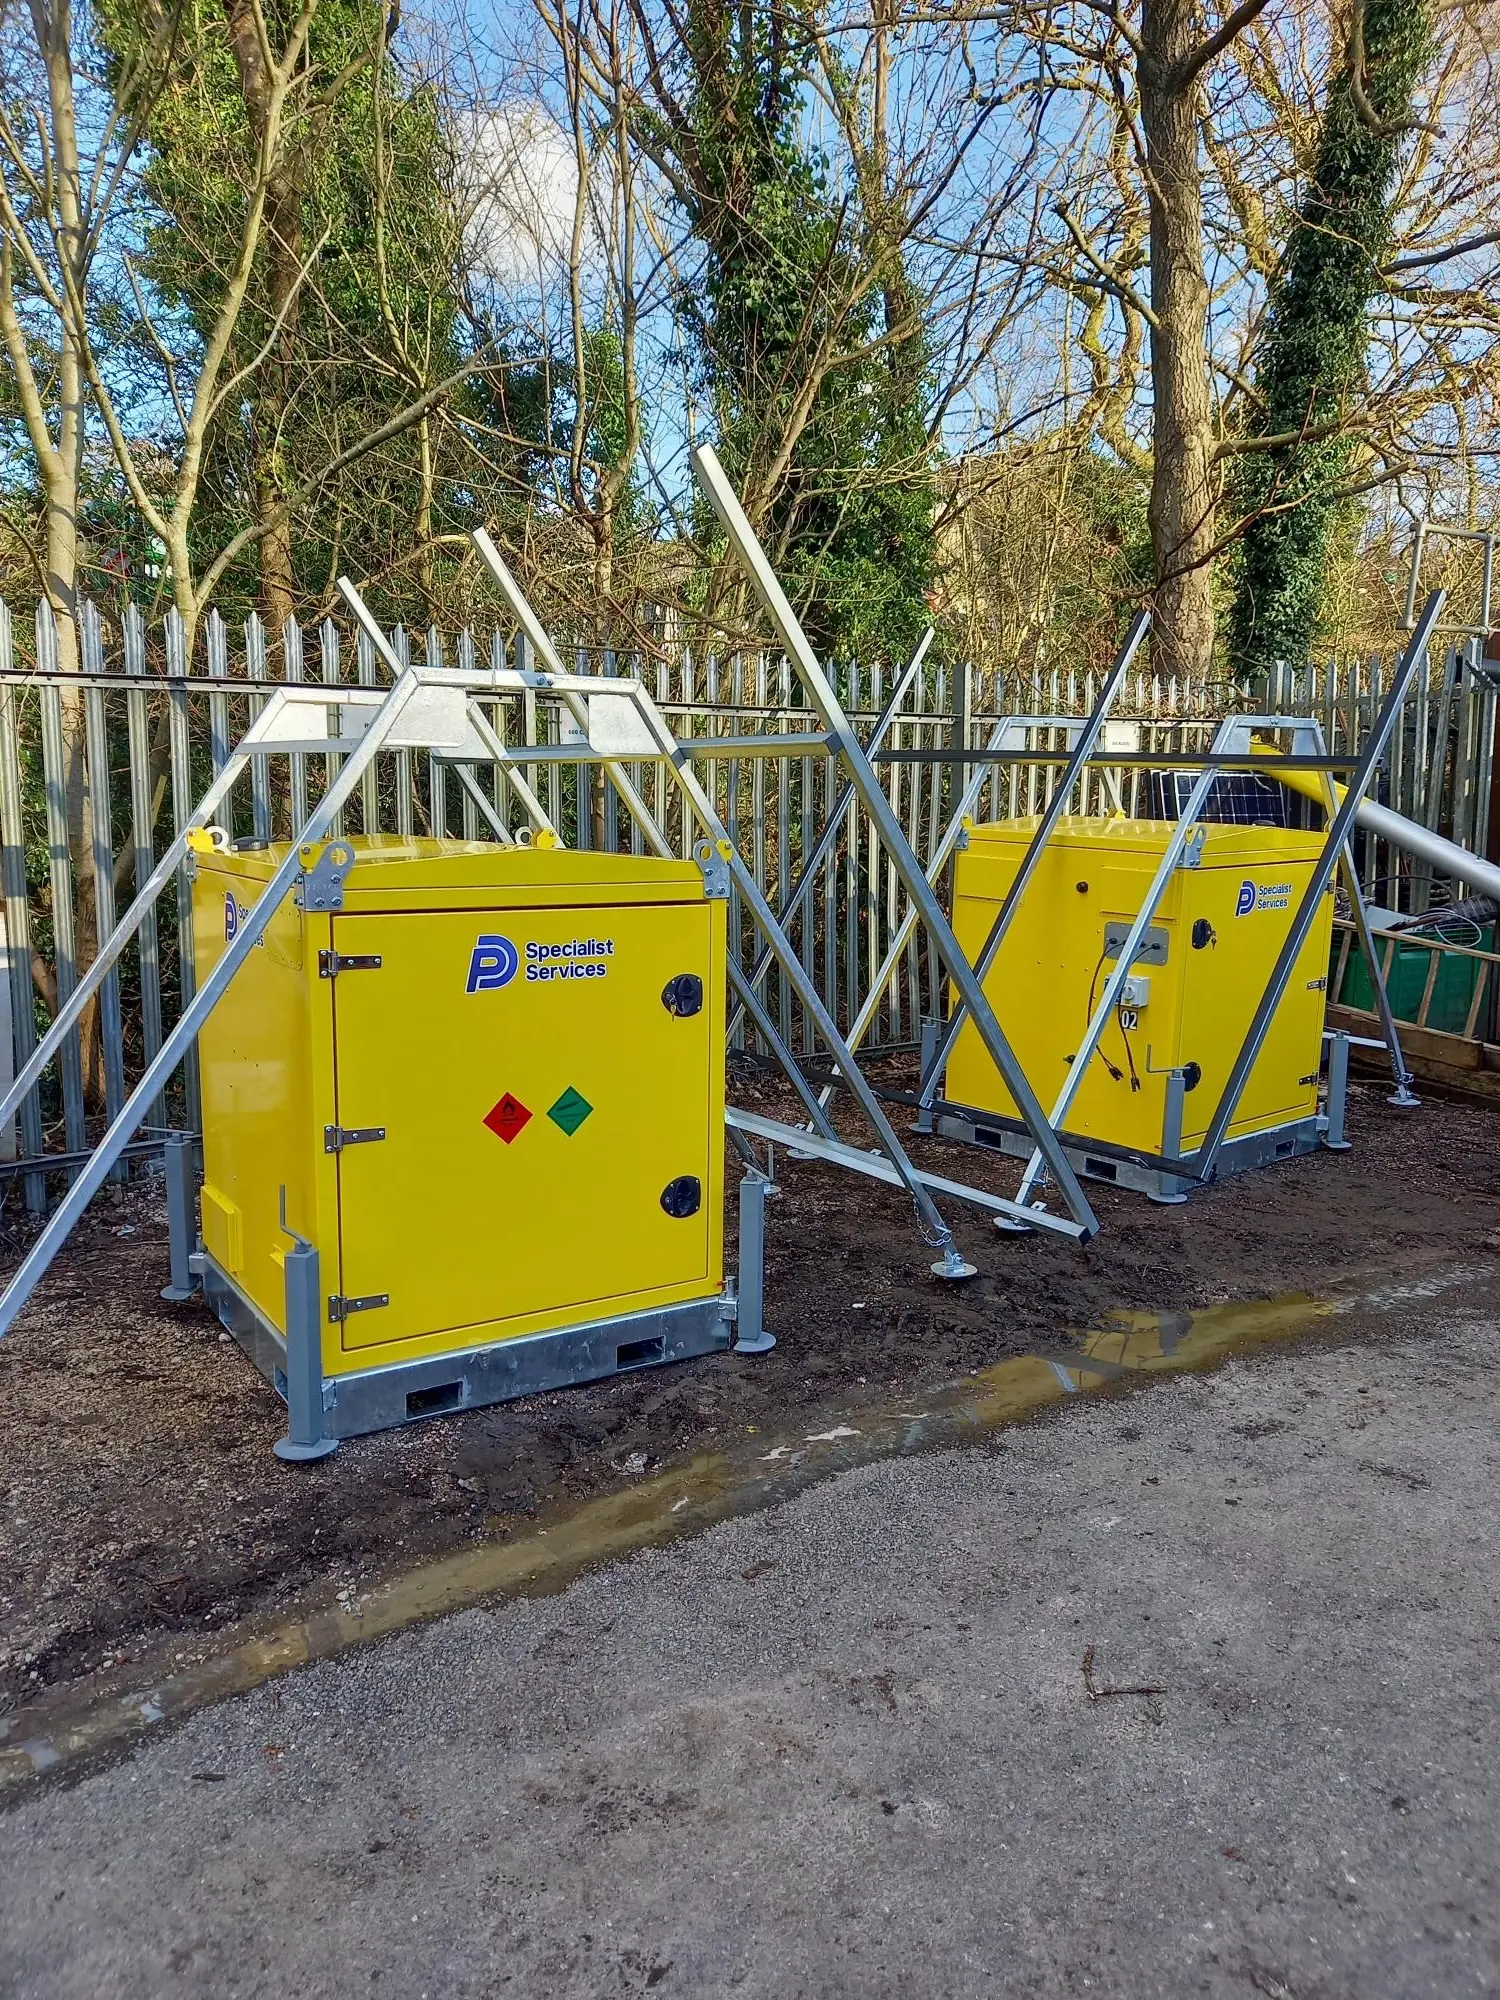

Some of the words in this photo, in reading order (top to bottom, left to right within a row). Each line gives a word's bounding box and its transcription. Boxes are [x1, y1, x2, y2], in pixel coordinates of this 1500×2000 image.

[1258, 884, 1292, 896] Specialist
[1258, 899, 1288, 909] Services
[526, 939, 613, 962] Specialist
[526, 961, 606, 980] Services
[1121, 1010, 1137, 1029] 02
